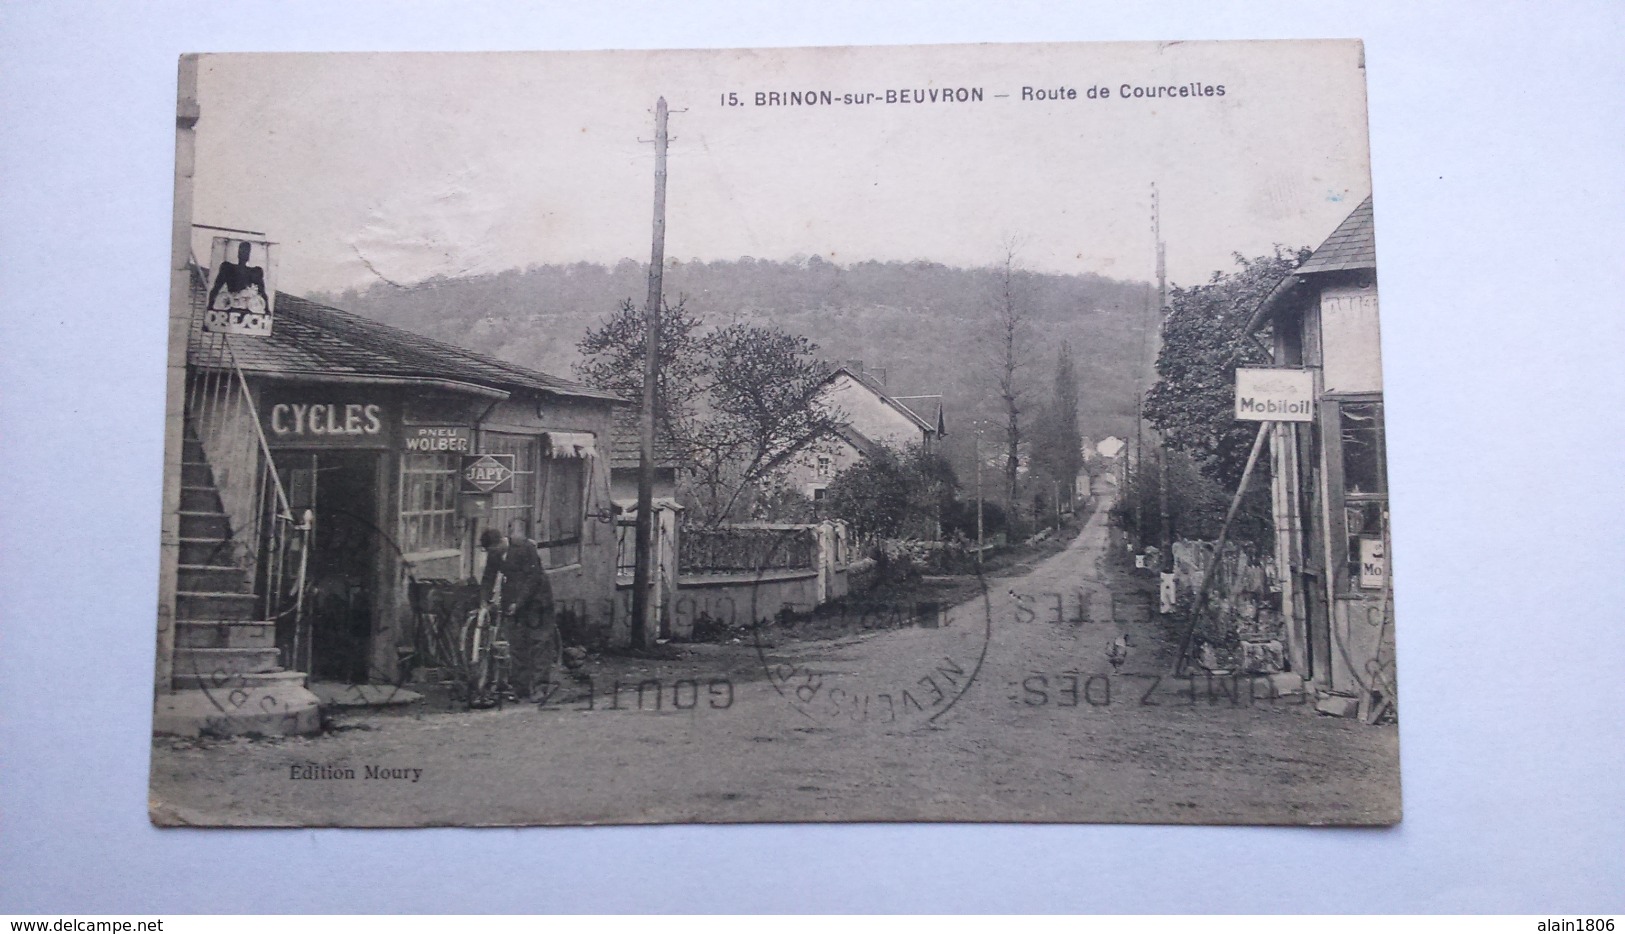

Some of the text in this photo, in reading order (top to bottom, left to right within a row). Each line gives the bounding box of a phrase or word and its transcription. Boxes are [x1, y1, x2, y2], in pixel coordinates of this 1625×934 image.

[719, 93, 746, 108] 15.
[754, 87, 984, 106] BRINON-sur-BEUVRON
[1021, 86, 1077, 102] Route
[1086, 85, 1111, 100] de
[1119, 81, 1227, 100] Courcelles
[1240, 397, 1311, 414] Mobiloil
[271, 403, 381, 434] CYCLES
[418, 428, 457, 437] PNEU
[406, 437, 468, 452] WOLBER
[467, 467, 505, 480] JAPY
[289, 765, 424, 783] Edition Moury
